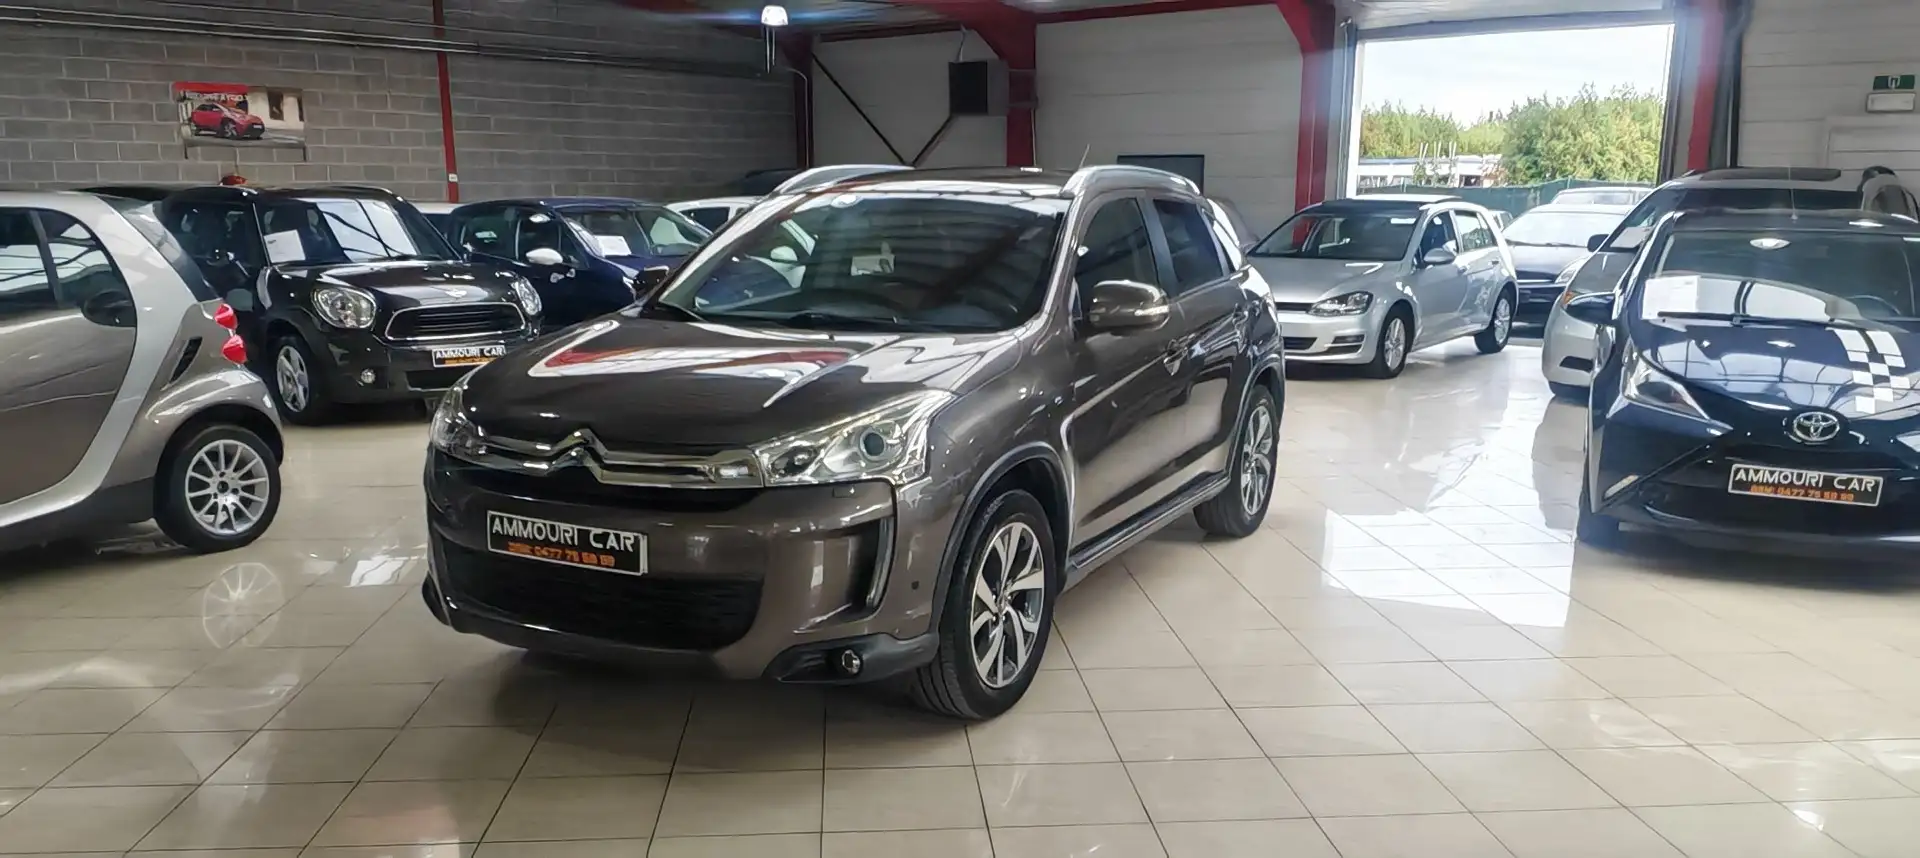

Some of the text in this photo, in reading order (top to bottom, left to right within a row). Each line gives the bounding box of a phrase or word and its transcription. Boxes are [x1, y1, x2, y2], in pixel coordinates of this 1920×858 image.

[436, 344, 505, 359] AMMOURI CAR
[1735, 468, 1876, 492] AMMOURI CAR
[492, 516, 635, 552] AMMOURI CAR
